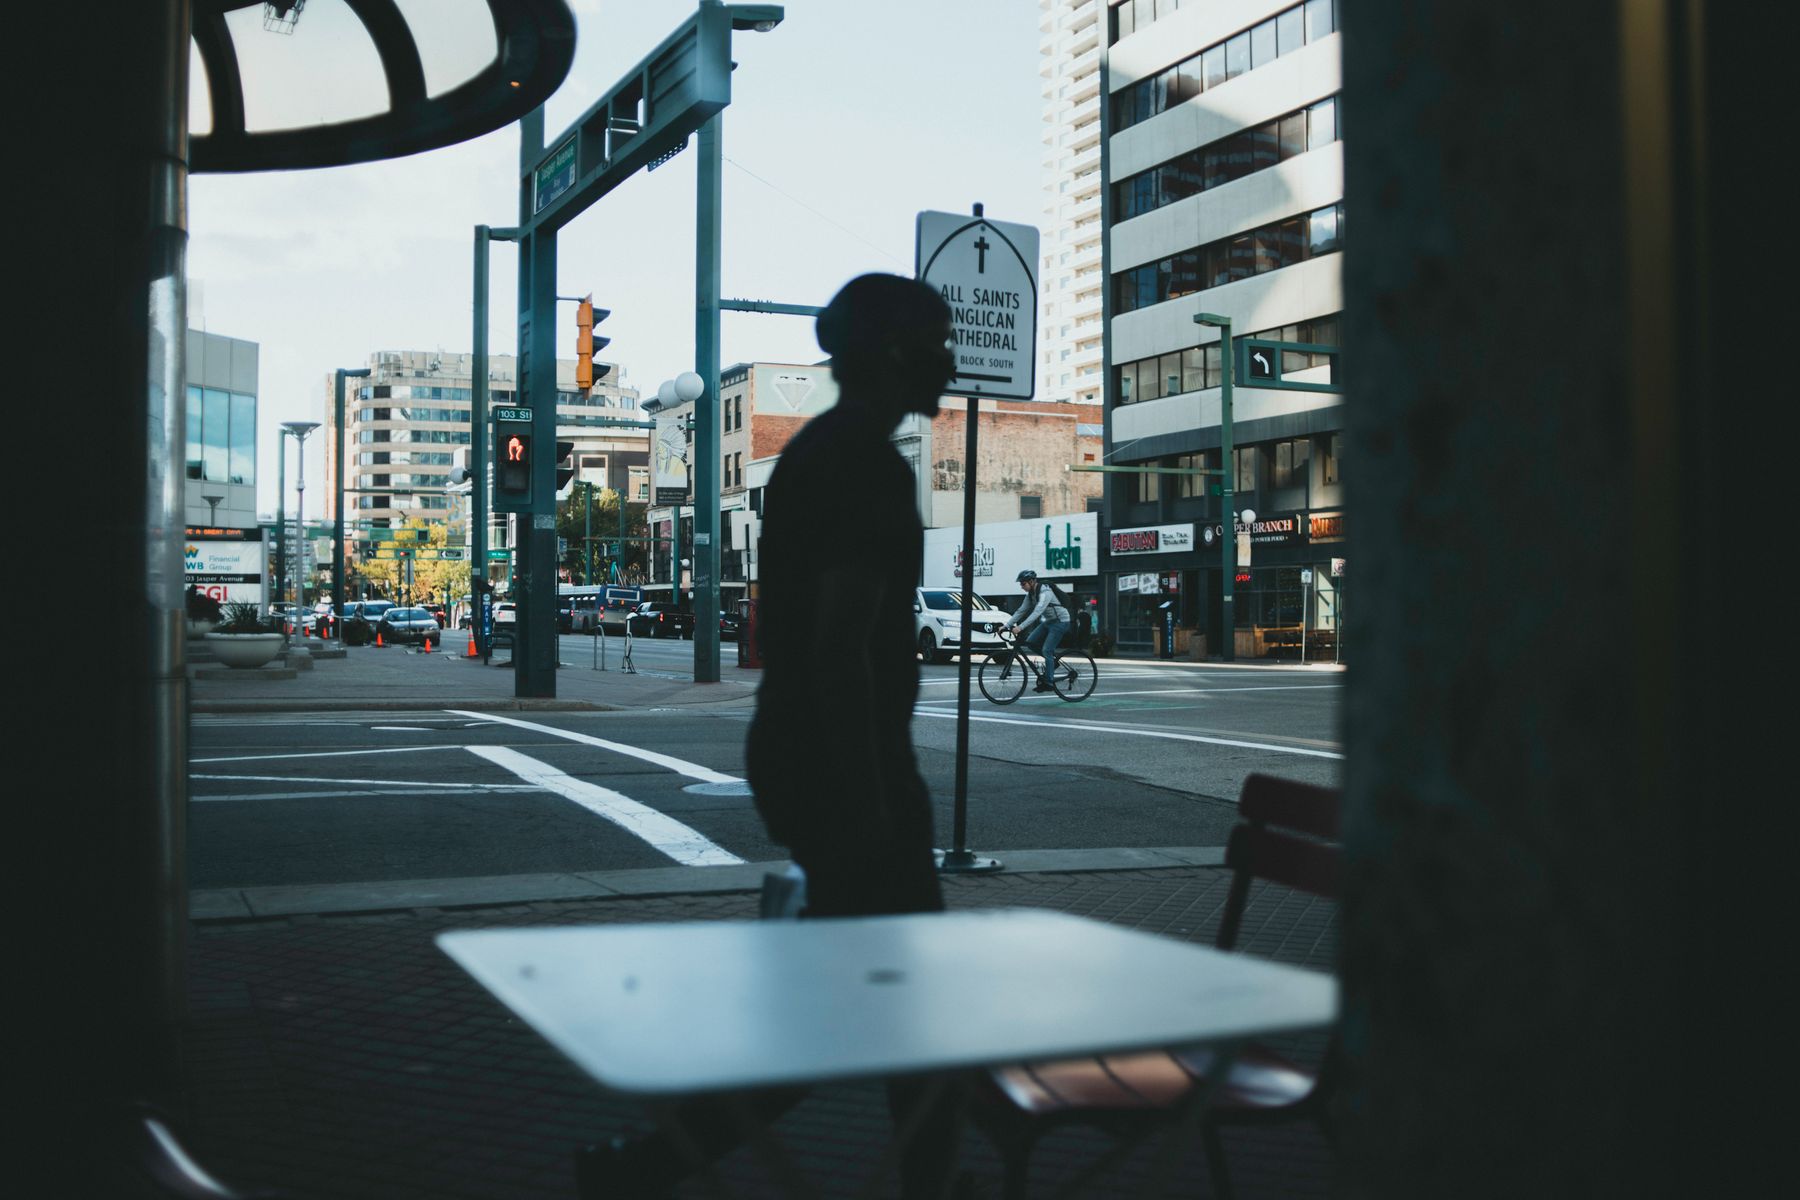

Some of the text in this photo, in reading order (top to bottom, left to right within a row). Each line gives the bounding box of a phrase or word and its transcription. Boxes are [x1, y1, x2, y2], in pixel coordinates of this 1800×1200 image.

[941, 284, 1020, 310] ALL SAINTS
[950, 328, 1018, 351] ATHEDRAL
[960, 355, 1014, 369] BLOCK SOUTH
[500, 410, 529, 419] 103 St
[1215, 519, 1291, 536] CPER BRANCH
[1111, 530, 1158, 551] FABUTAN
[185, 561, 204, 570] WB
[196, 575, 217, 583] Jasper
